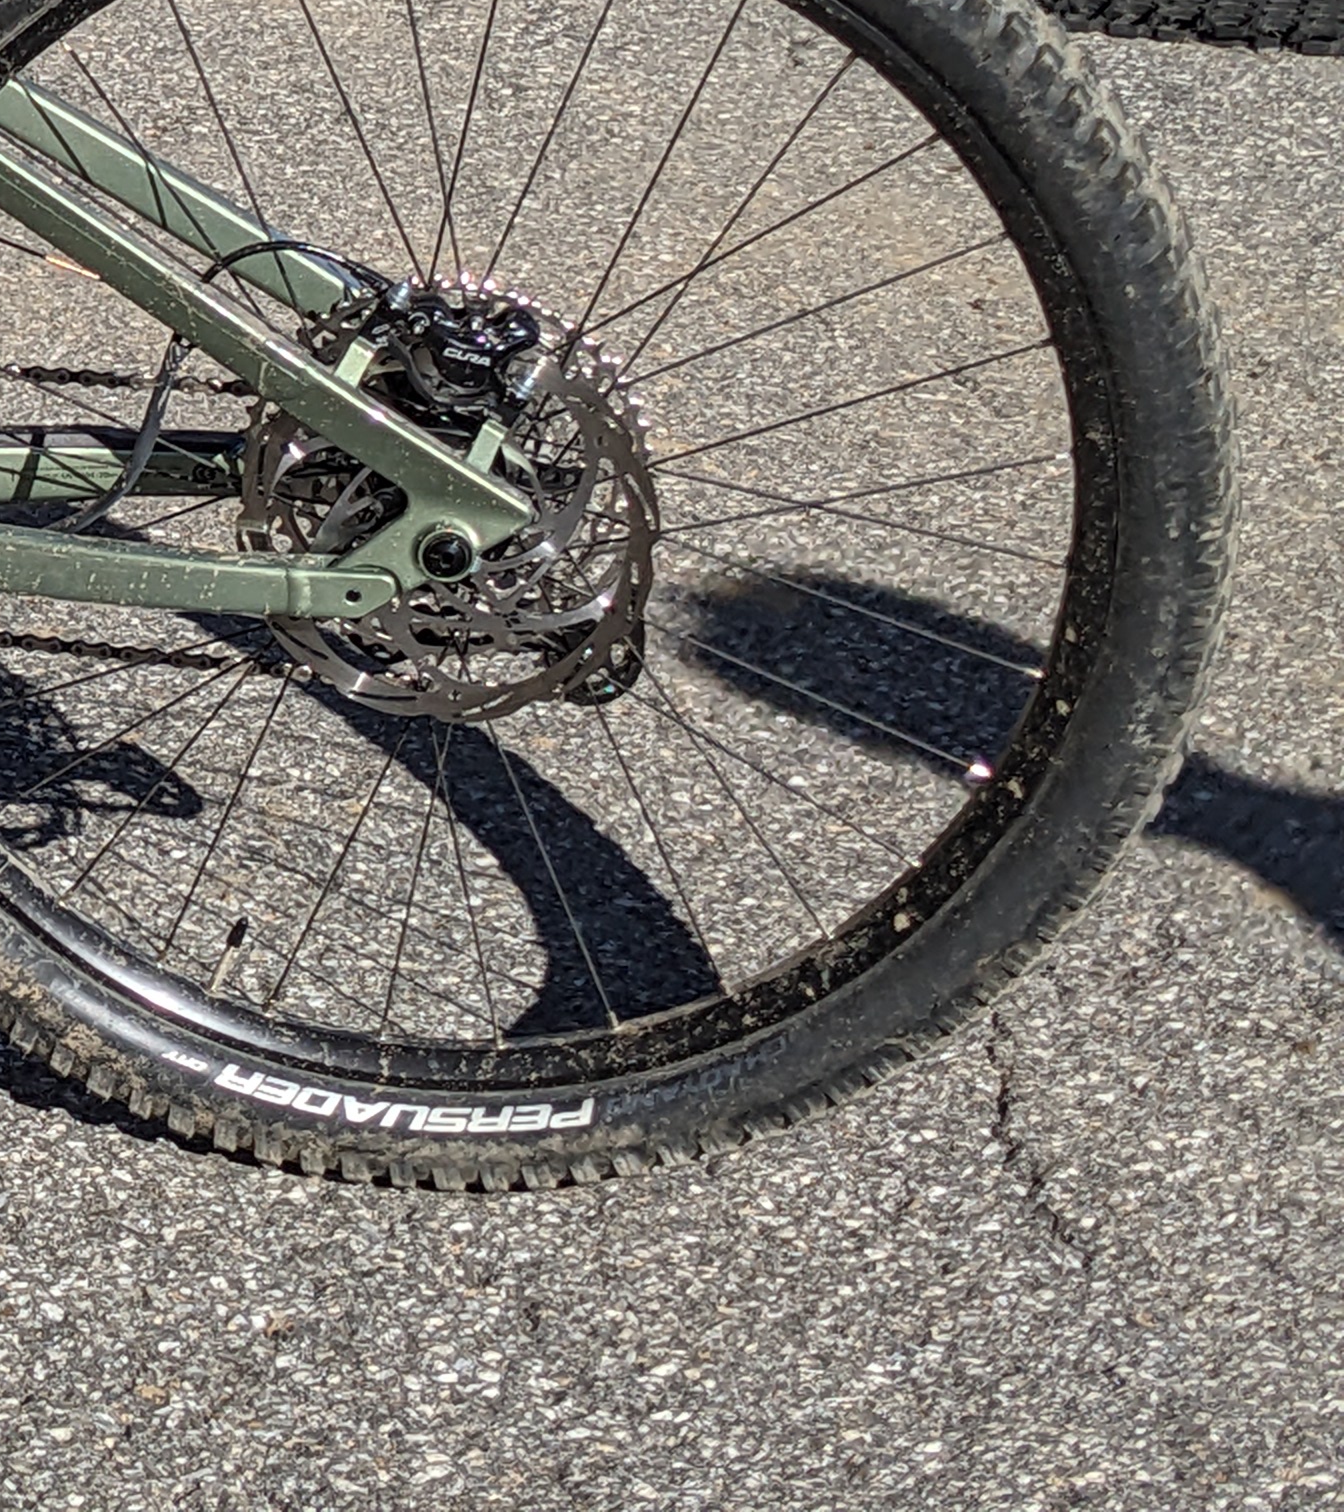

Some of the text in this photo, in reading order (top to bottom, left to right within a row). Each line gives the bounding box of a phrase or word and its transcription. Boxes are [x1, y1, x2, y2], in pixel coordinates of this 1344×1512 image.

[442, 347, 492, 368] CURA
[160, 1050, 596, 1136] PERSUADER DRY
